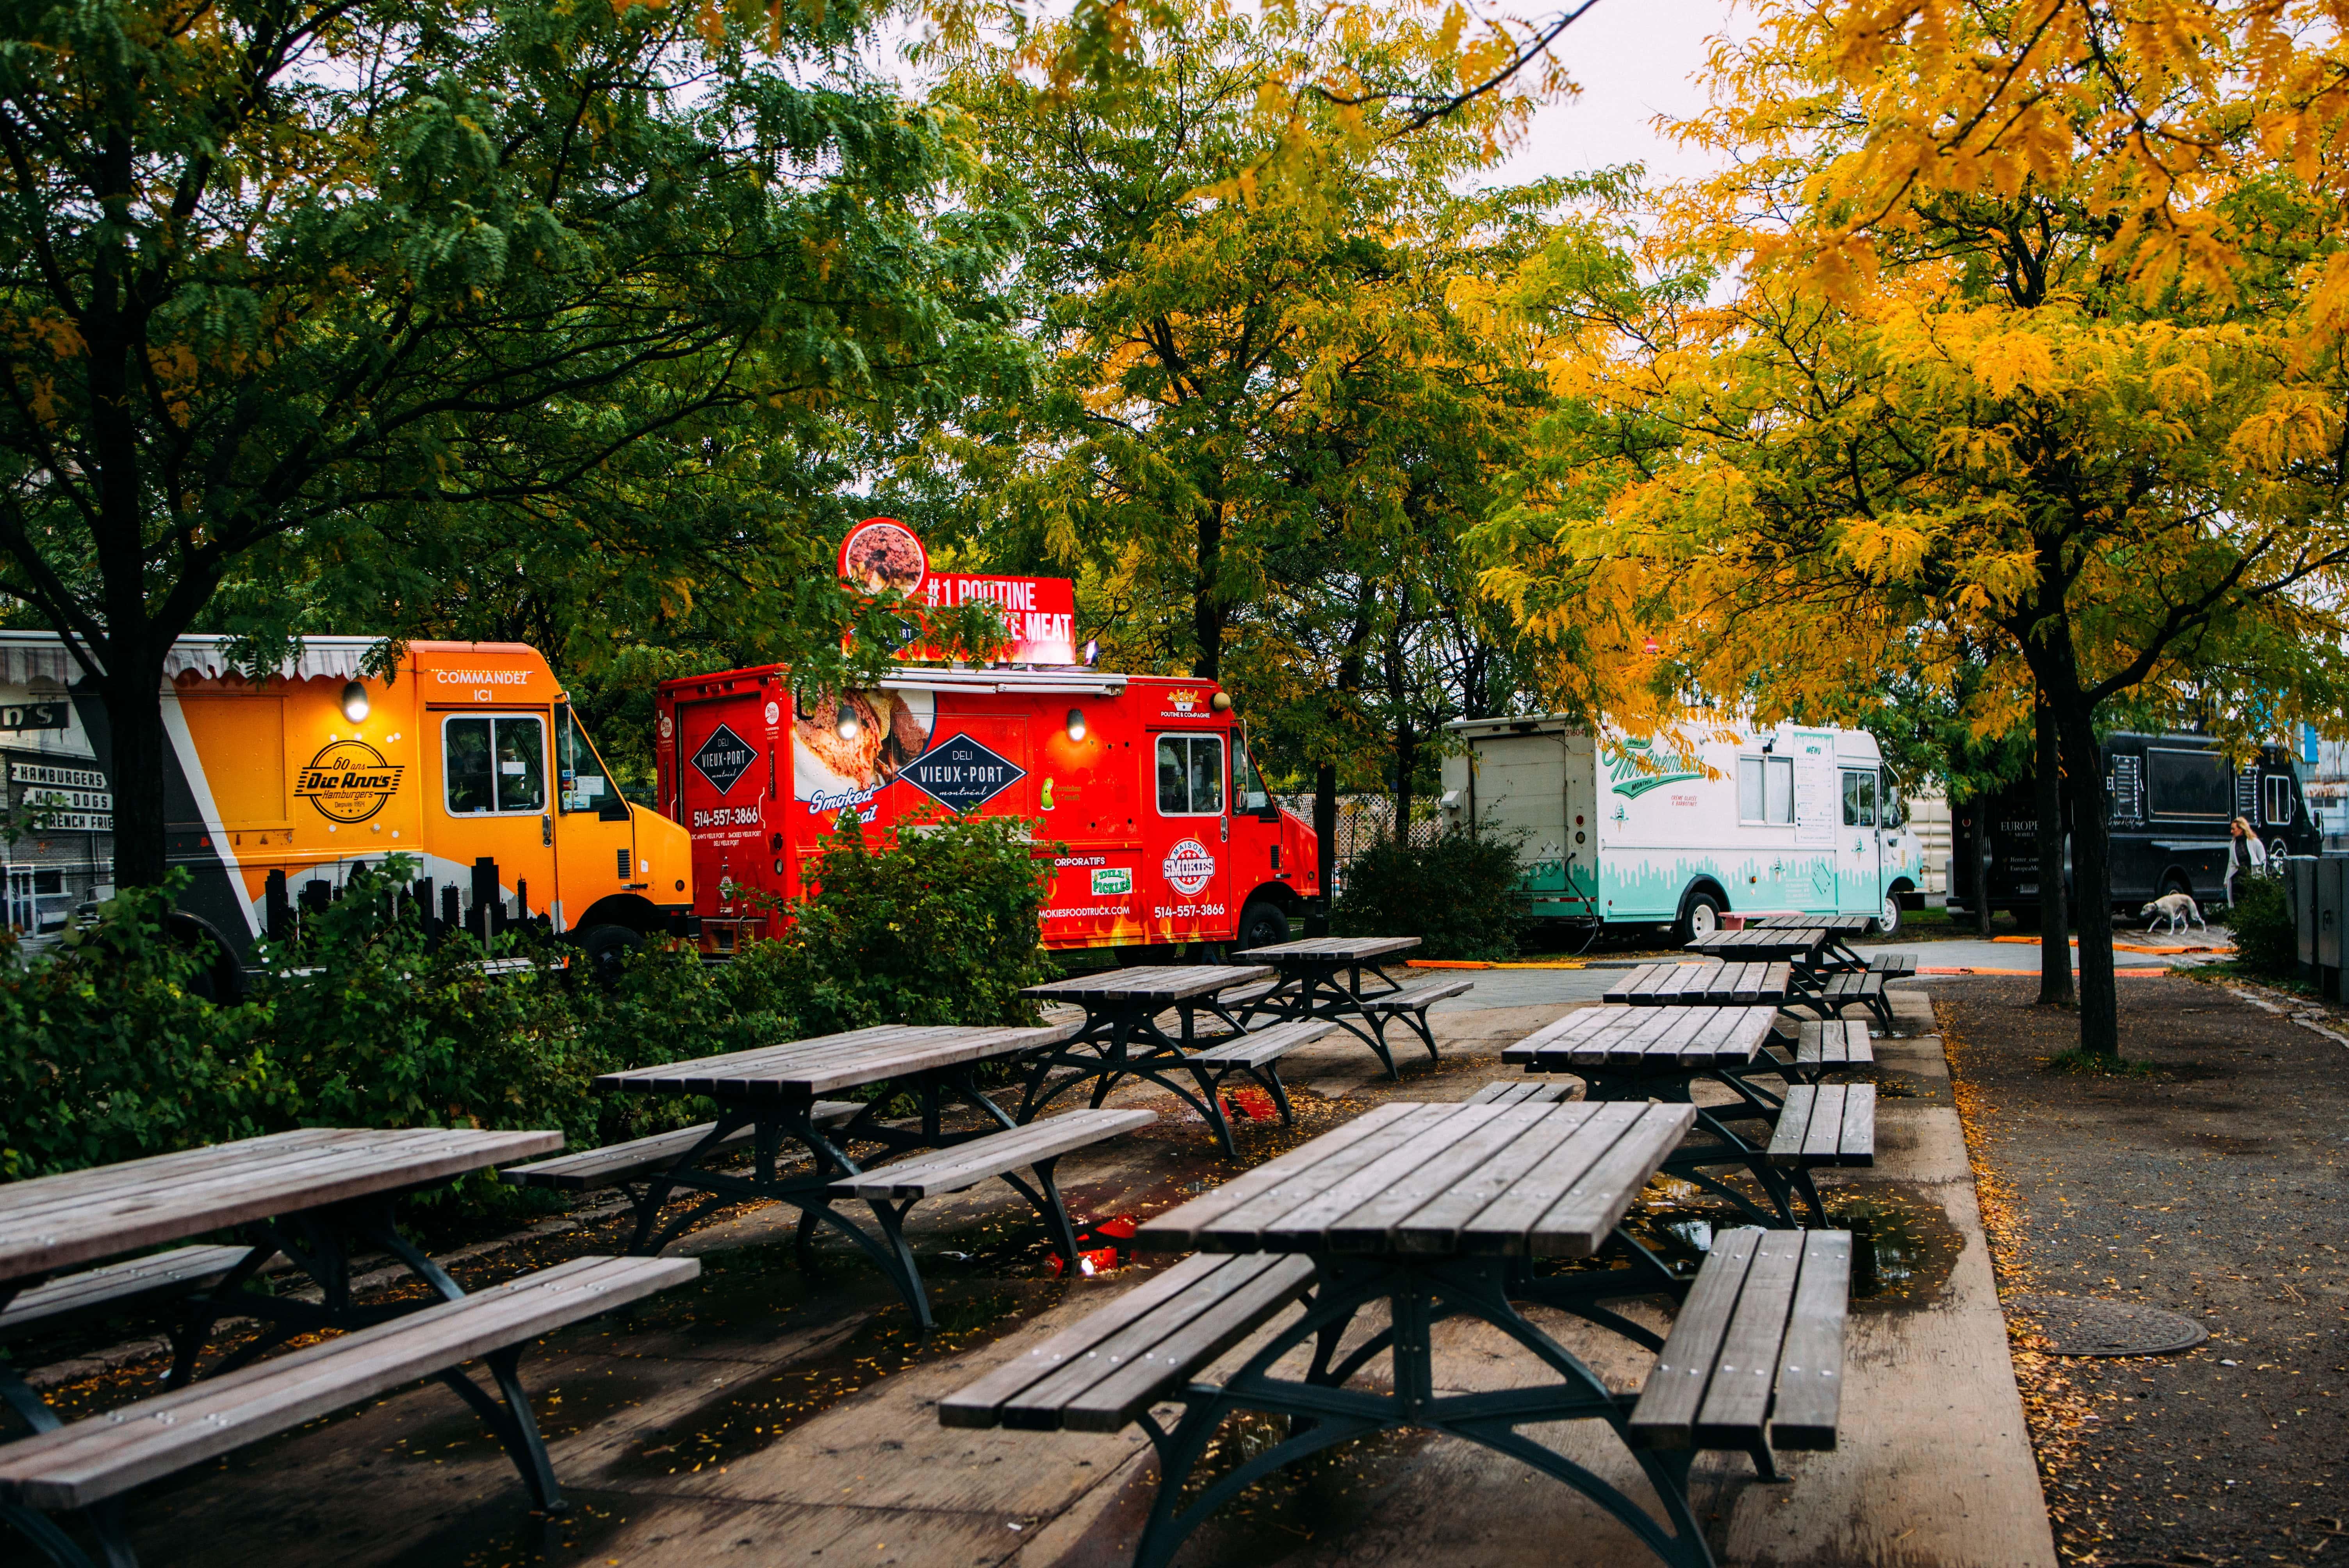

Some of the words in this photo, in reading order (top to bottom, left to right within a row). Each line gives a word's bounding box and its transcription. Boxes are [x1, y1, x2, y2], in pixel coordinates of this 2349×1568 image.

[958, 579, 1037, 610] POUTINE
[1025, 612, 1072, 642] MEAT
[437, 672, 527, 684] COMMANDEZ
[474, 690, 492, 702] ICI
[718, 738, 729, 747] DELI
[952, 750, 973, 760] DELI
[1806, 746, 1821, 755] MENU
[333, 757, 350, 770] 60
[702, 750, 745, 768] VIEUX-PORT
[21, 766, 103, 787] HAMBURGERS
[307, 773, 339, 789] Dic
[340, 772, 391, 788] Ann's
[920, 766, 1003, 782] VIEUX-PORT
[322, 790, 374, 800] Hamburgers
[939, 786, 987, 796] montréal
[809, 784, 875, 814] Smoked
[91, 814, 113, 829] FRIE
[693, 807, 758, 827] 514-557-3866
[2001, 820, 2039, 831] EUROPE
[1173, 842, 1203, 856] MAISON
[1054, 857, 1105, 866] ORPORATIFS
[1163, 857, 1214, 878] SMOKIES
[1099, 869, 1125, 879] DILL
[1093, 879, 1131, 894] PICKLES
[1174, 878, 1197, 893] CHARCUTERIE
[1038, 906, 1130, 918] MOKIESFOODTRUCK.COM
[1154, 903, 1225, 918] 514-557-3866
